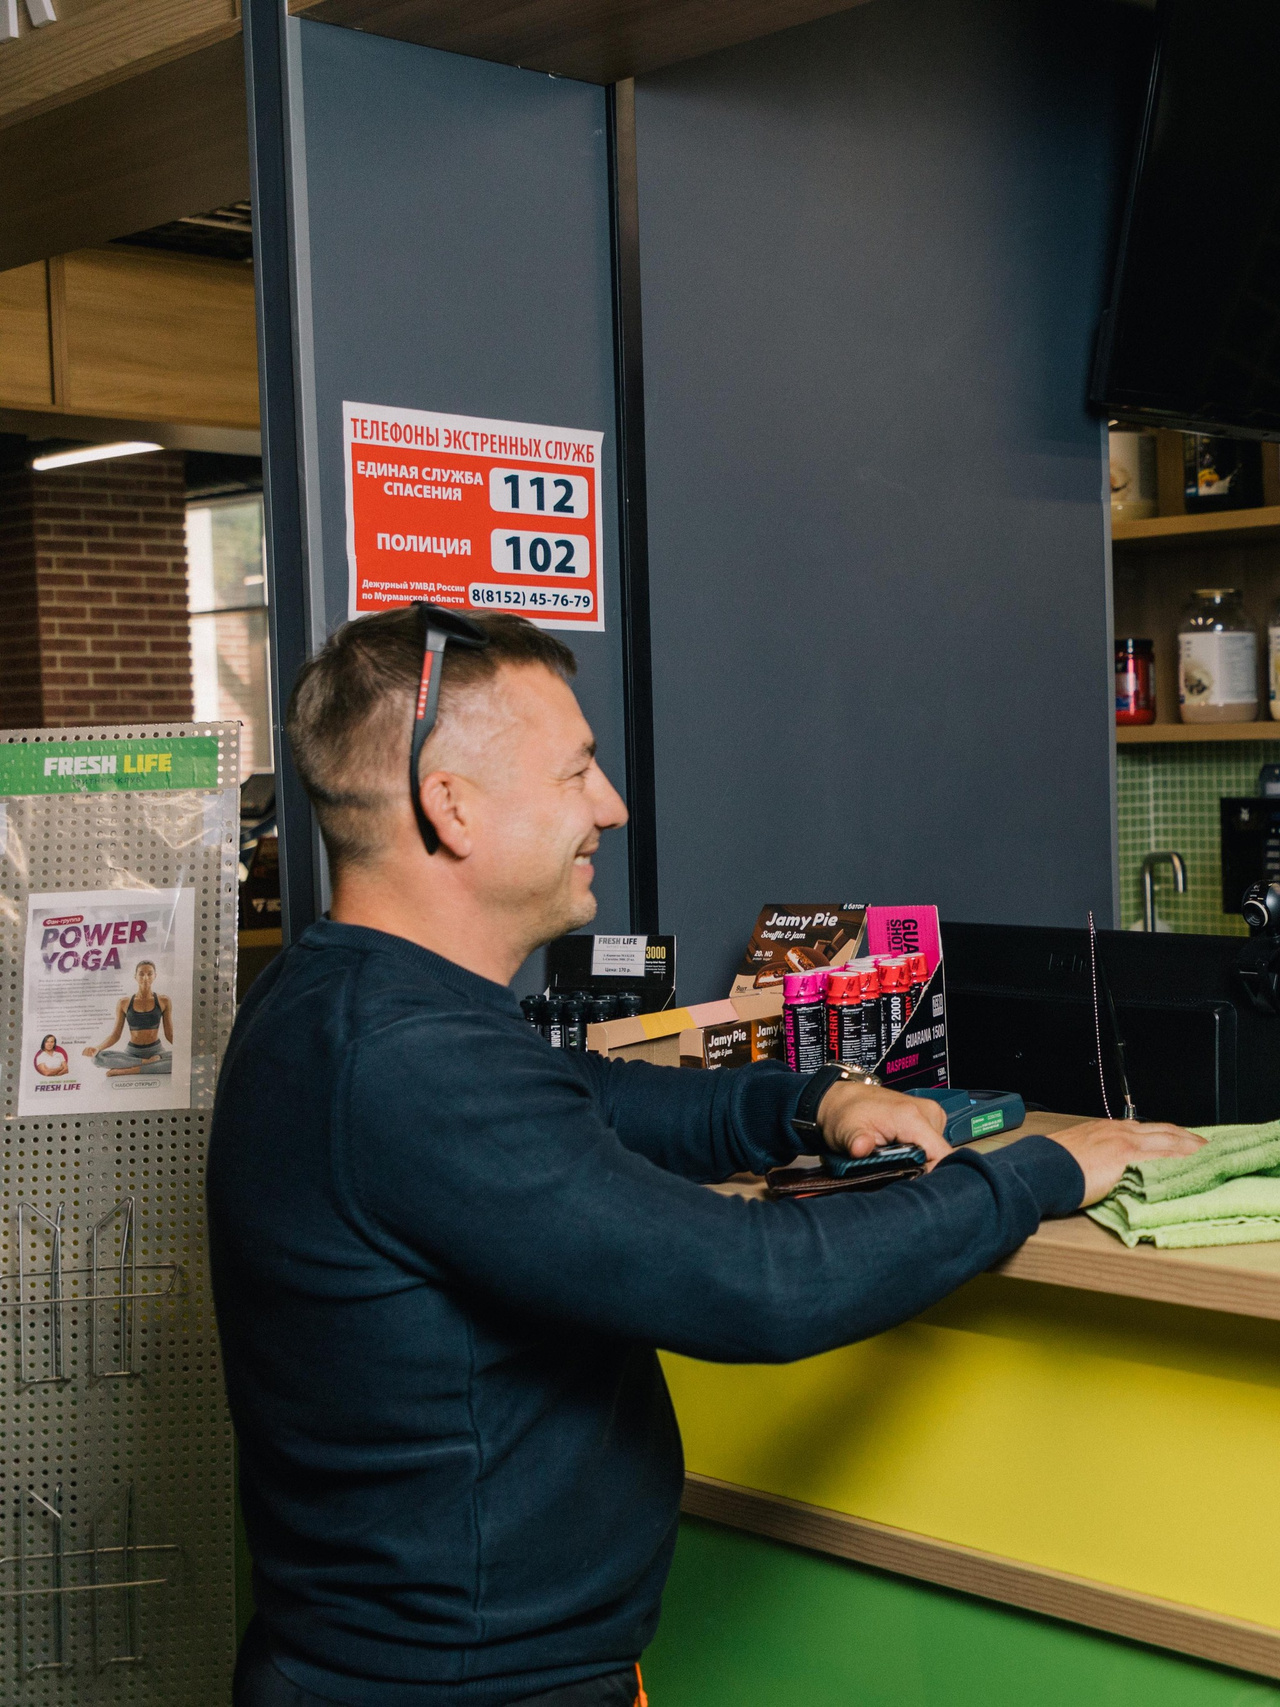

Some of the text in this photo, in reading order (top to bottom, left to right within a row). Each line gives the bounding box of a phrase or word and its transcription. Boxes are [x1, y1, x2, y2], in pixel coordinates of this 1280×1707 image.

[350, 418, 595, 463] ТЕЛЕФОНЫ ЭКСТРЕННЫХ СЛУЖБ
[356, 461, 484, 486] ЕДИНАЯ СЛУЖБА
[383, 482, 462, 501] СПАСЕНИЯ
[503, 474, 575, 514] 112
[376, 533, 472, 558] ПОЛИЦИЯ
[505, 536, 576, 574] 102
[362, 579, 466, 593] Дежурный УМВД России
[374, 591, 429, 603] Мурманской
[430, 594, 465, 604] области
[471, 588, 591, 608] 8(8152) 45-76-79
[44, 753, 172, 776] FRESH LIFE
[765, 912, 838, 930] Jamy Pie
[40, 920, 148, 950] POWER
[598, 937, 621, 945] FRESH
[791, 931, 806, 941] jam
[890, 919, 903, 952] SHOT
[42, 947, 122, 973] YOGA
[645, 946, 666, 959] 3000
[891, 996, 902, 1021] 2000
[708, 1029, 747, 1048] Jamy Pie
[756, 1023, 779, 1037] Jamy
[829, 1009, 838, 1051] CHERRY
[905, 1023, 945, 1049] GUARANA 1500
[886, 1053, 920, 1075] RASPBERRY
[35, 1083, 82, 1092] FRESH LIFE
